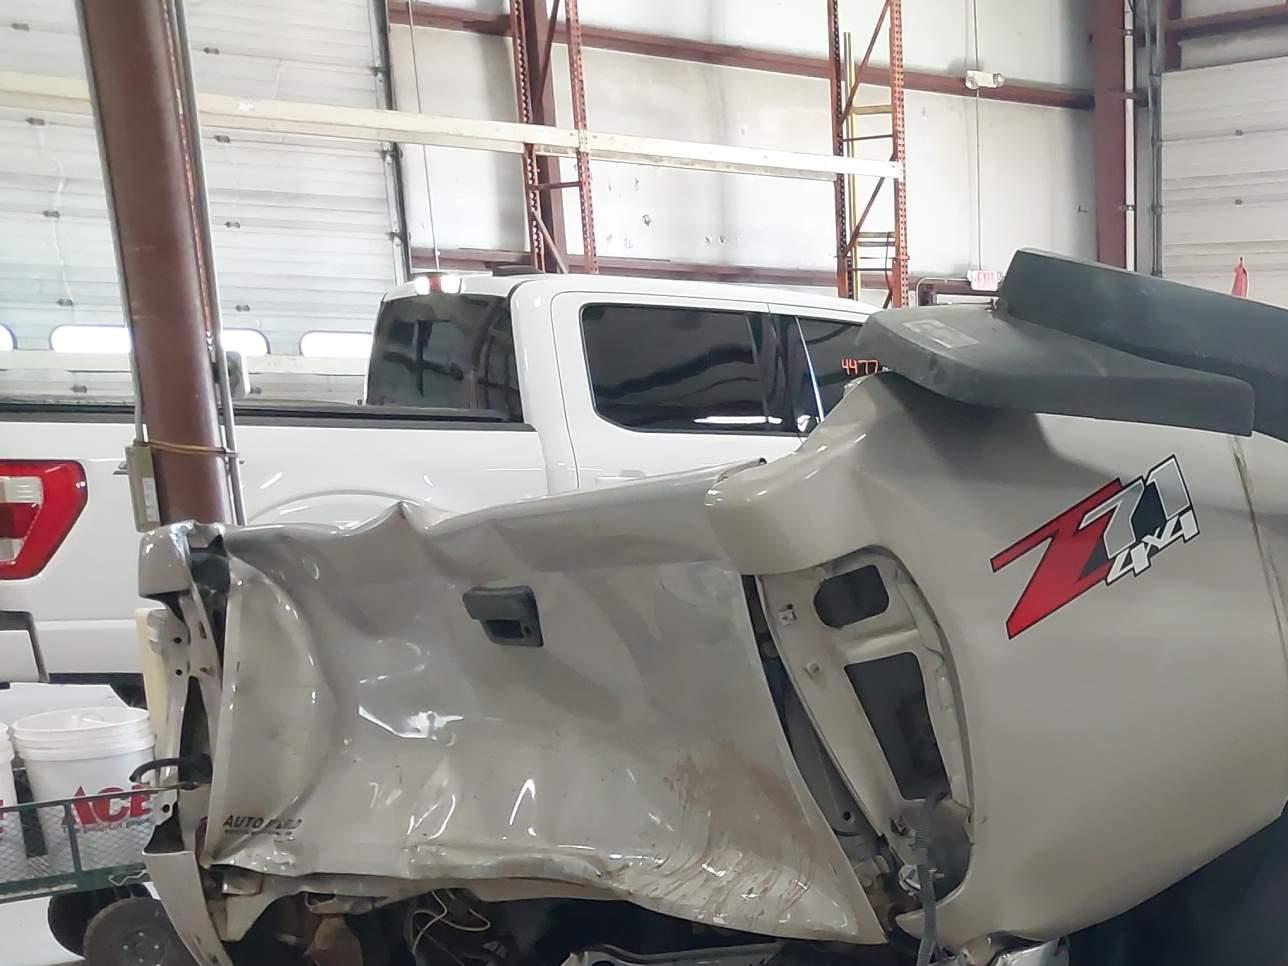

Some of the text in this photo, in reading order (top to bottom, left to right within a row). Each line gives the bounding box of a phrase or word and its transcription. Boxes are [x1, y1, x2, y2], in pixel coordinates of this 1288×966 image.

[990, 454, 1194, 640] Z71
[62, 784, 152, 825] ACE
[223, 814, 265, 829] AUTO
